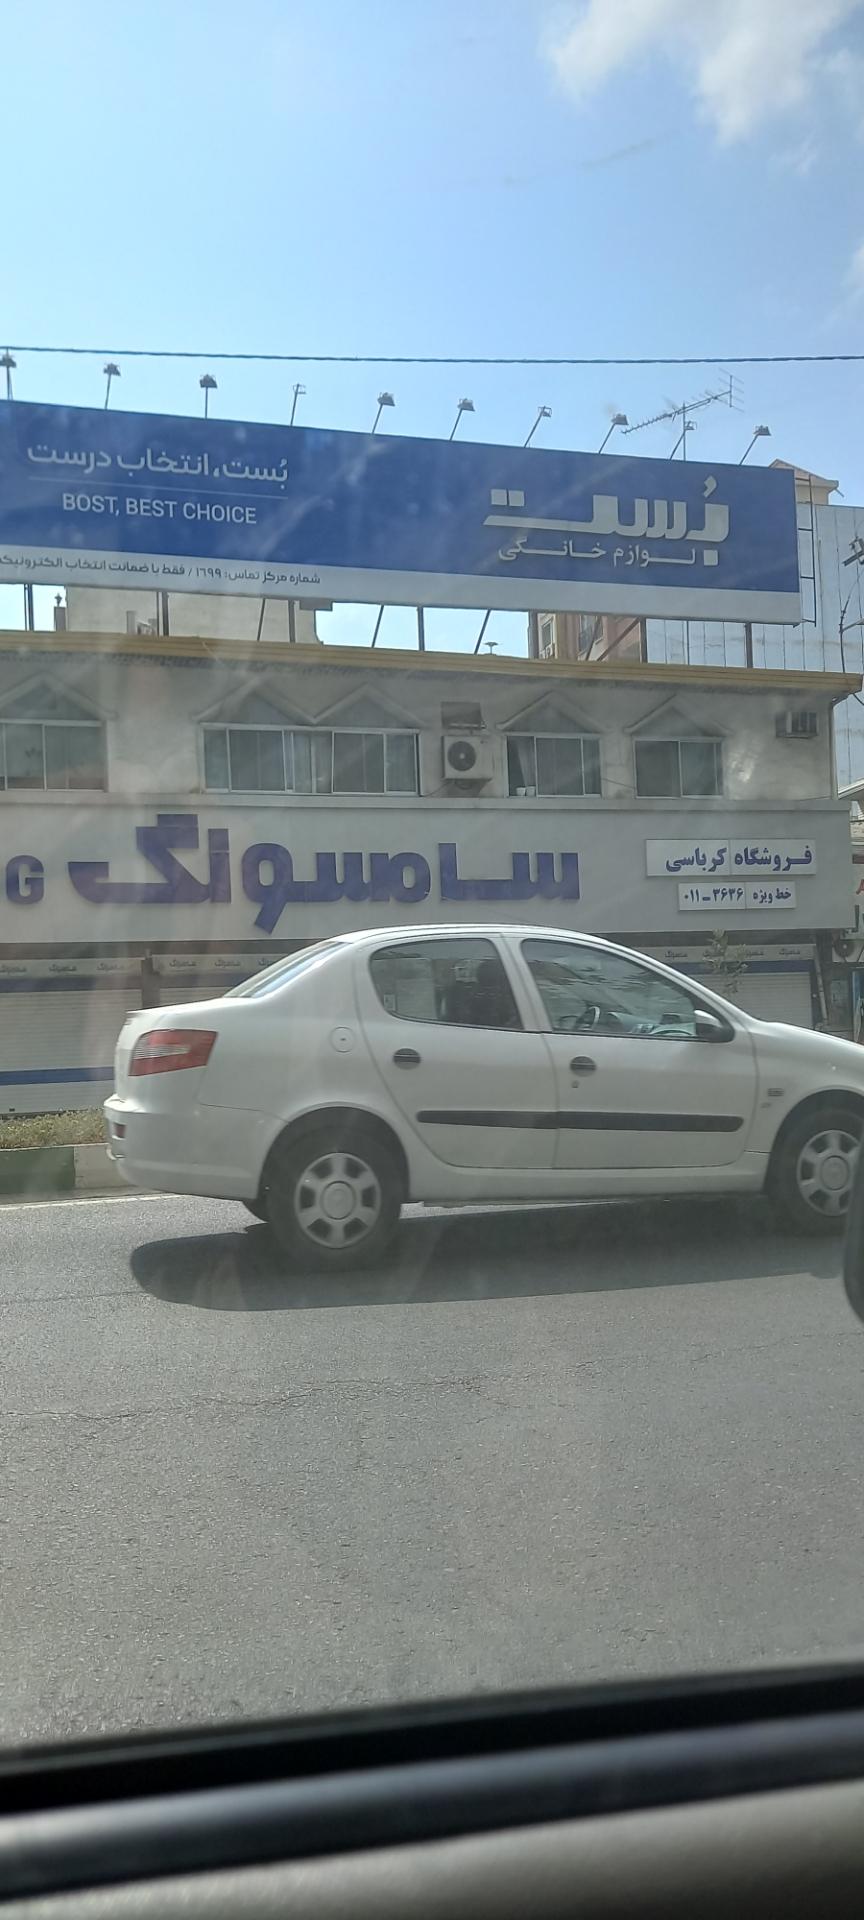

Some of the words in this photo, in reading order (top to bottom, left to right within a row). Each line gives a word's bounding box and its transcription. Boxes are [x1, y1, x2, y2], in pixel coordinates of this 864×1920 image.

[26, 444, 112, 474] درست
[62, 493, 120, 516] BOST,
[126, 499, 178, 519] BEST
[182, 503, 257, 525] CHOICE
[498, 536, 607, 562] خانگی
[65, 558, 106, 572] انتخاب
[613, 548, 696, 567] لوازم
[109, 561, 149, 573] ضمانت
[151, 562, 161, 577] با
[162, 564, 186, 575] فقط
[224, 568, 260, 582] تماس:
[262, 570, 287, 585] مرکز
[289, 572, 321, 586] شماره
[665, 847, 727, 872] کرباسی
[734, 845, 813, 872] فروشگاه
[68, 814, 580, 934] سامسونگ
[752, 889, 773, 904] ویژه
[775, 888, 792, 900] خط
